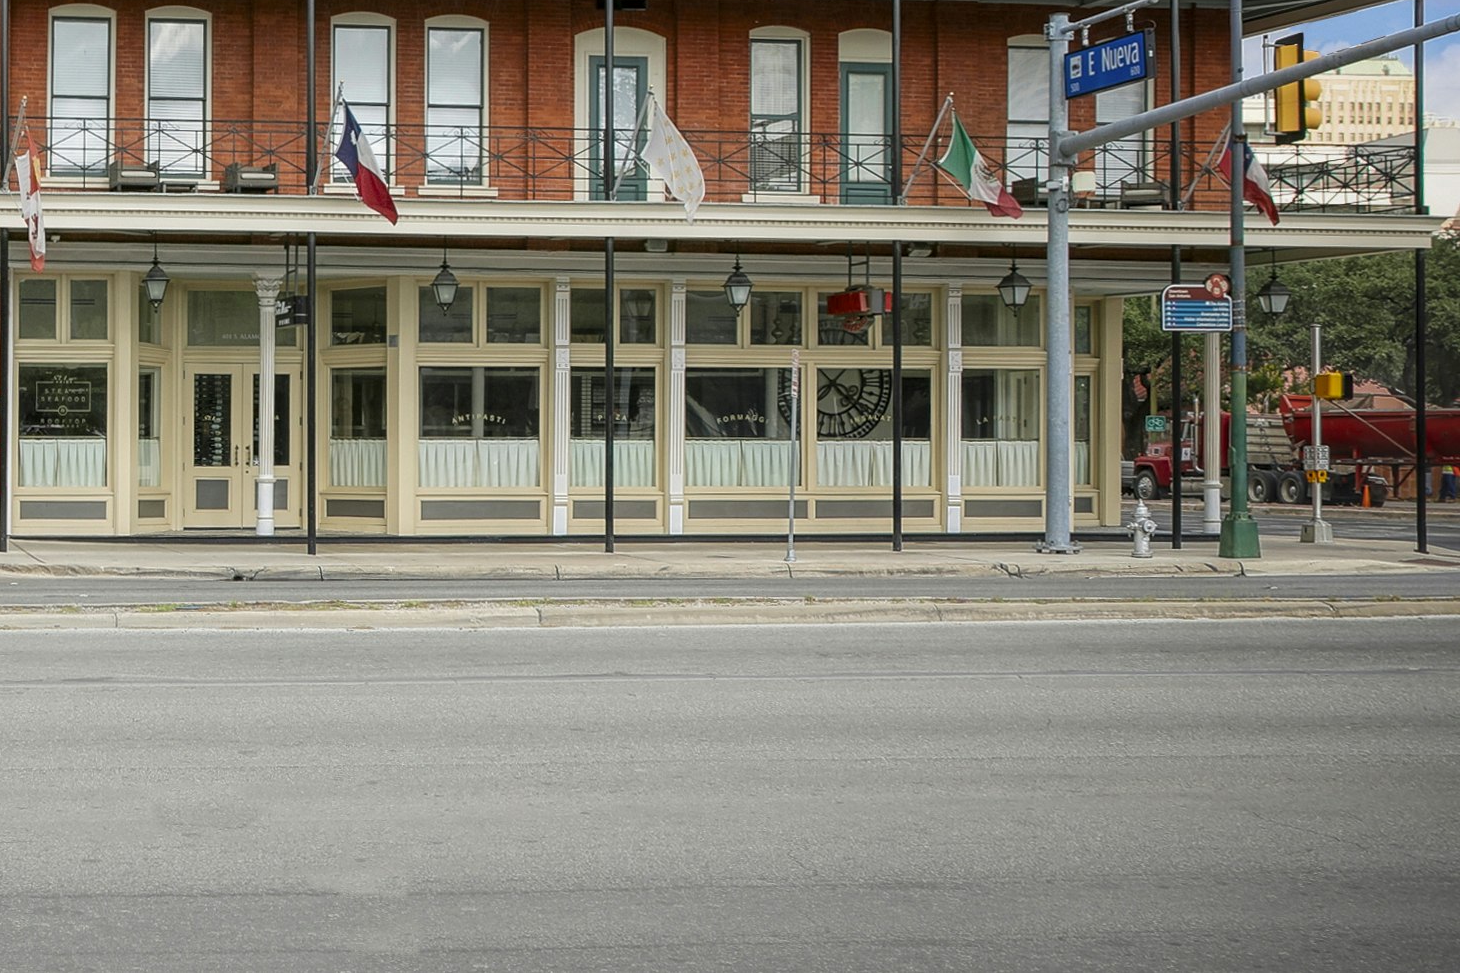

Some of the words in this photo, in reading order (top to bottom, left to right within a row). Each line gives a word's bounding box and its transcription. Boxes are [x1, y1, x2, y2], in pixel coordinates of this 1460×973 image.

[1088, 51, 1095, 76] E
[1101, 42, 1140, 72] Nueva
[452, 413, 506, 425] ANTIPASTI
